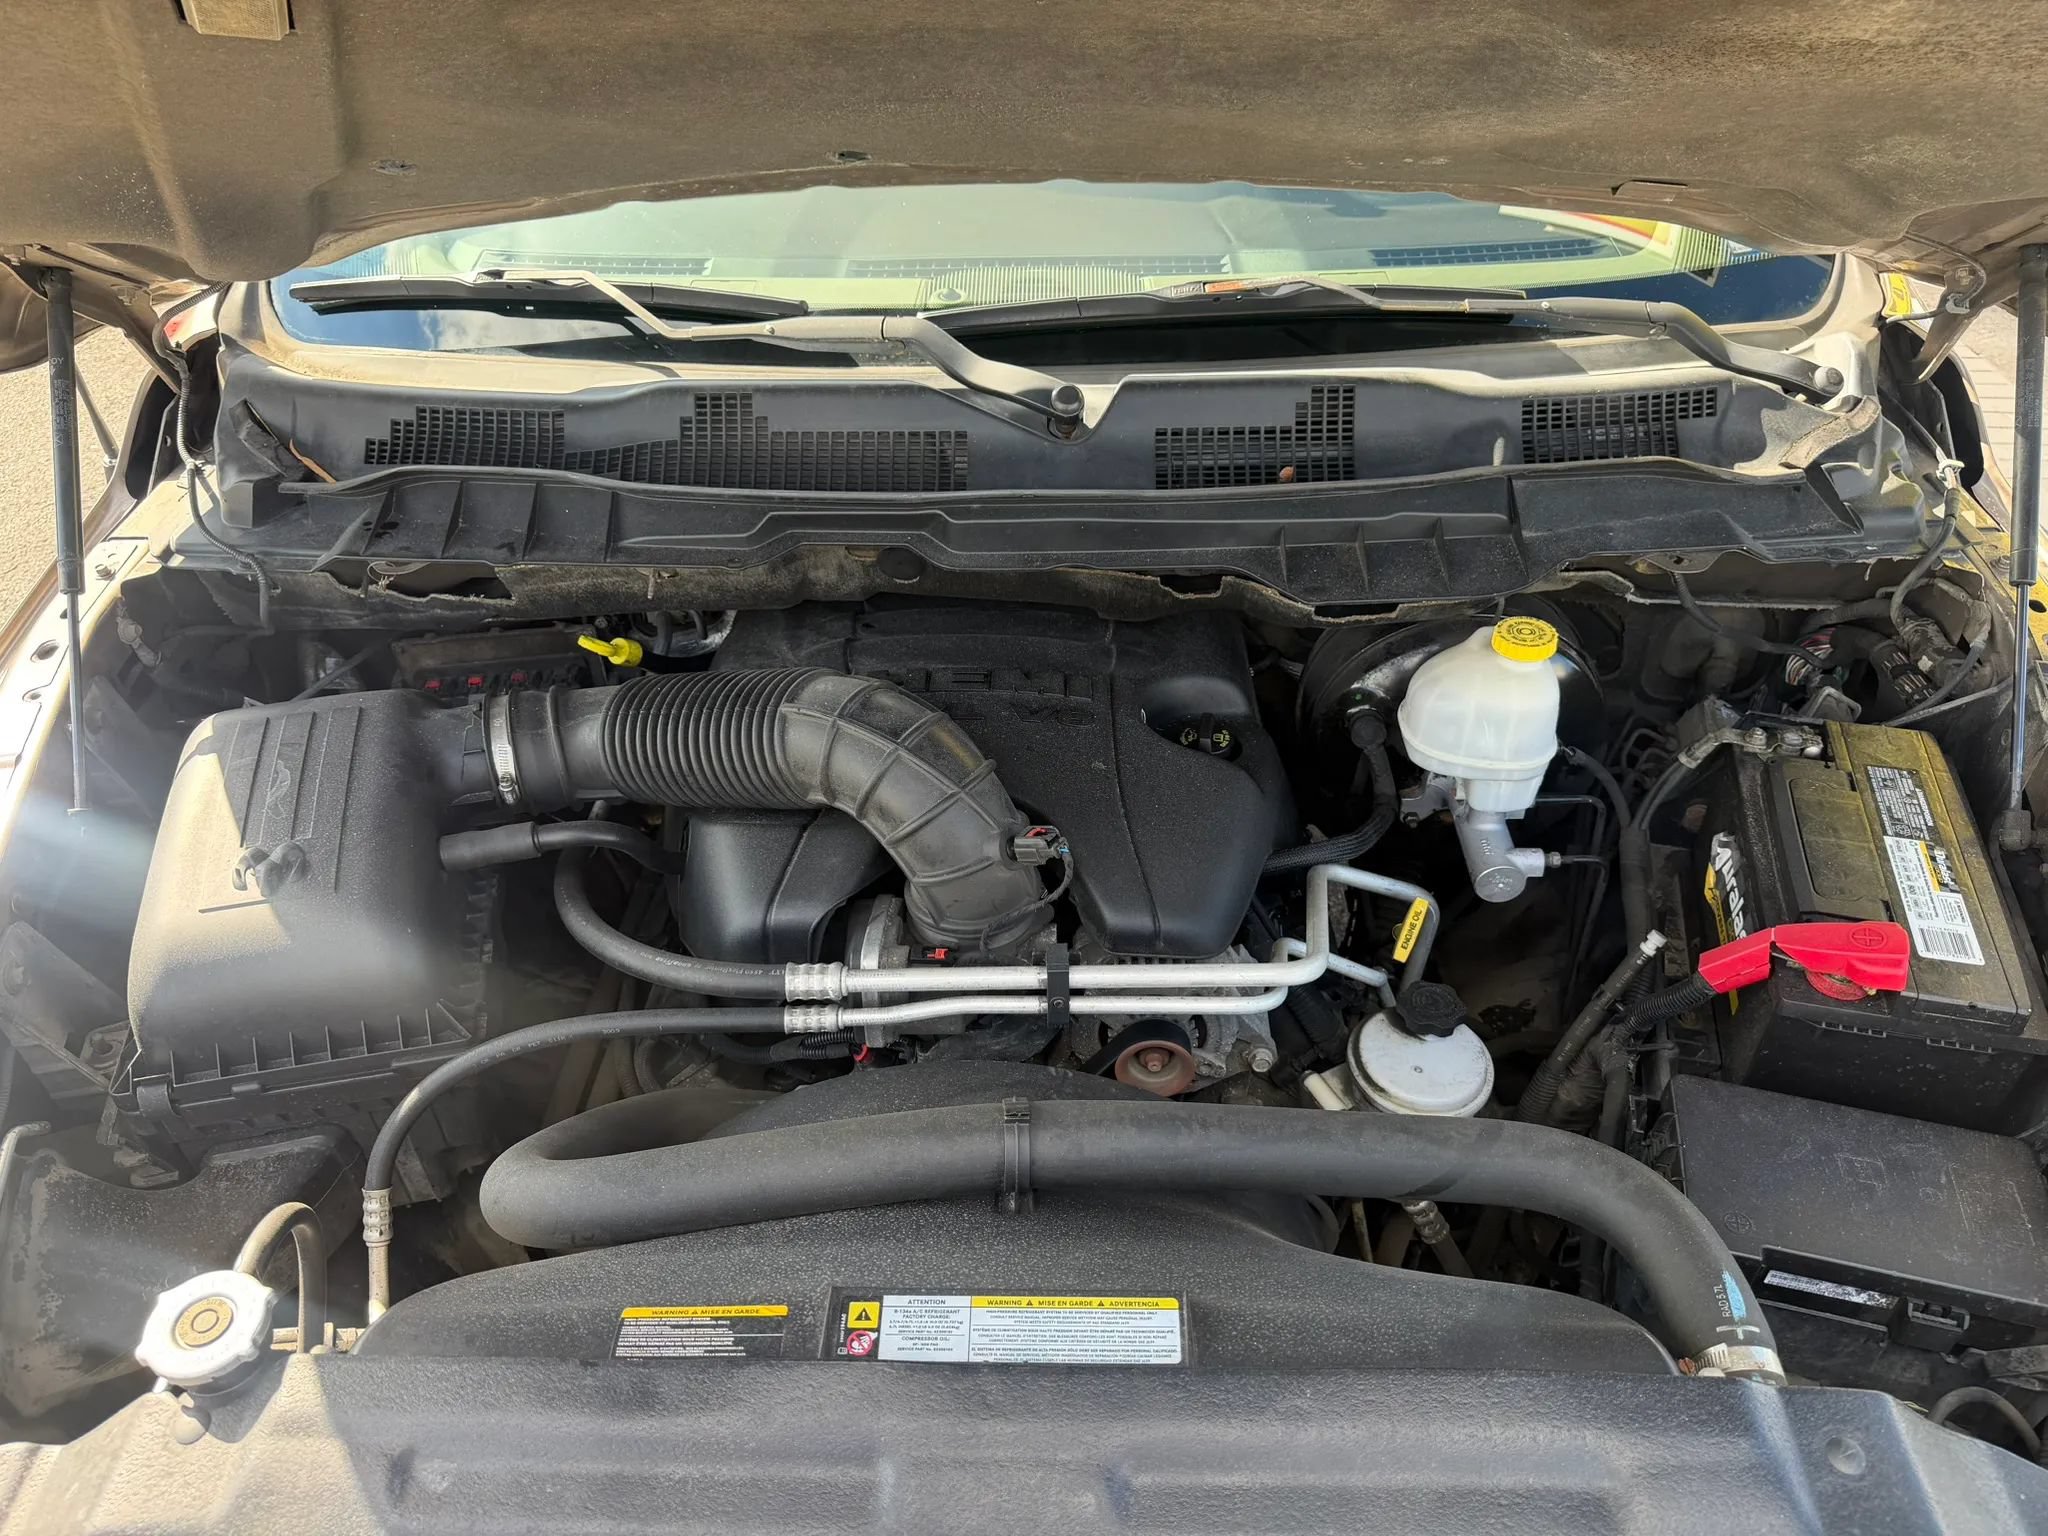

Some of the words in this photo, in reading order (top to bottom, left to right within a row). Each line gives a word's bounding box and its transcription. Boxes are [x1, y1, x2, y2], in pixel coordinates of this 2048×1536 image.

[1935, 849, 1955, 886] Duralast
[1401, 921, 1417, 950] ENGINE
[1412, 908, 1423, 922] OIL
[1109, 1300, 1160, 1308] ADVERTENCIA
[1718, 1300, 1732, 1318] RAD
